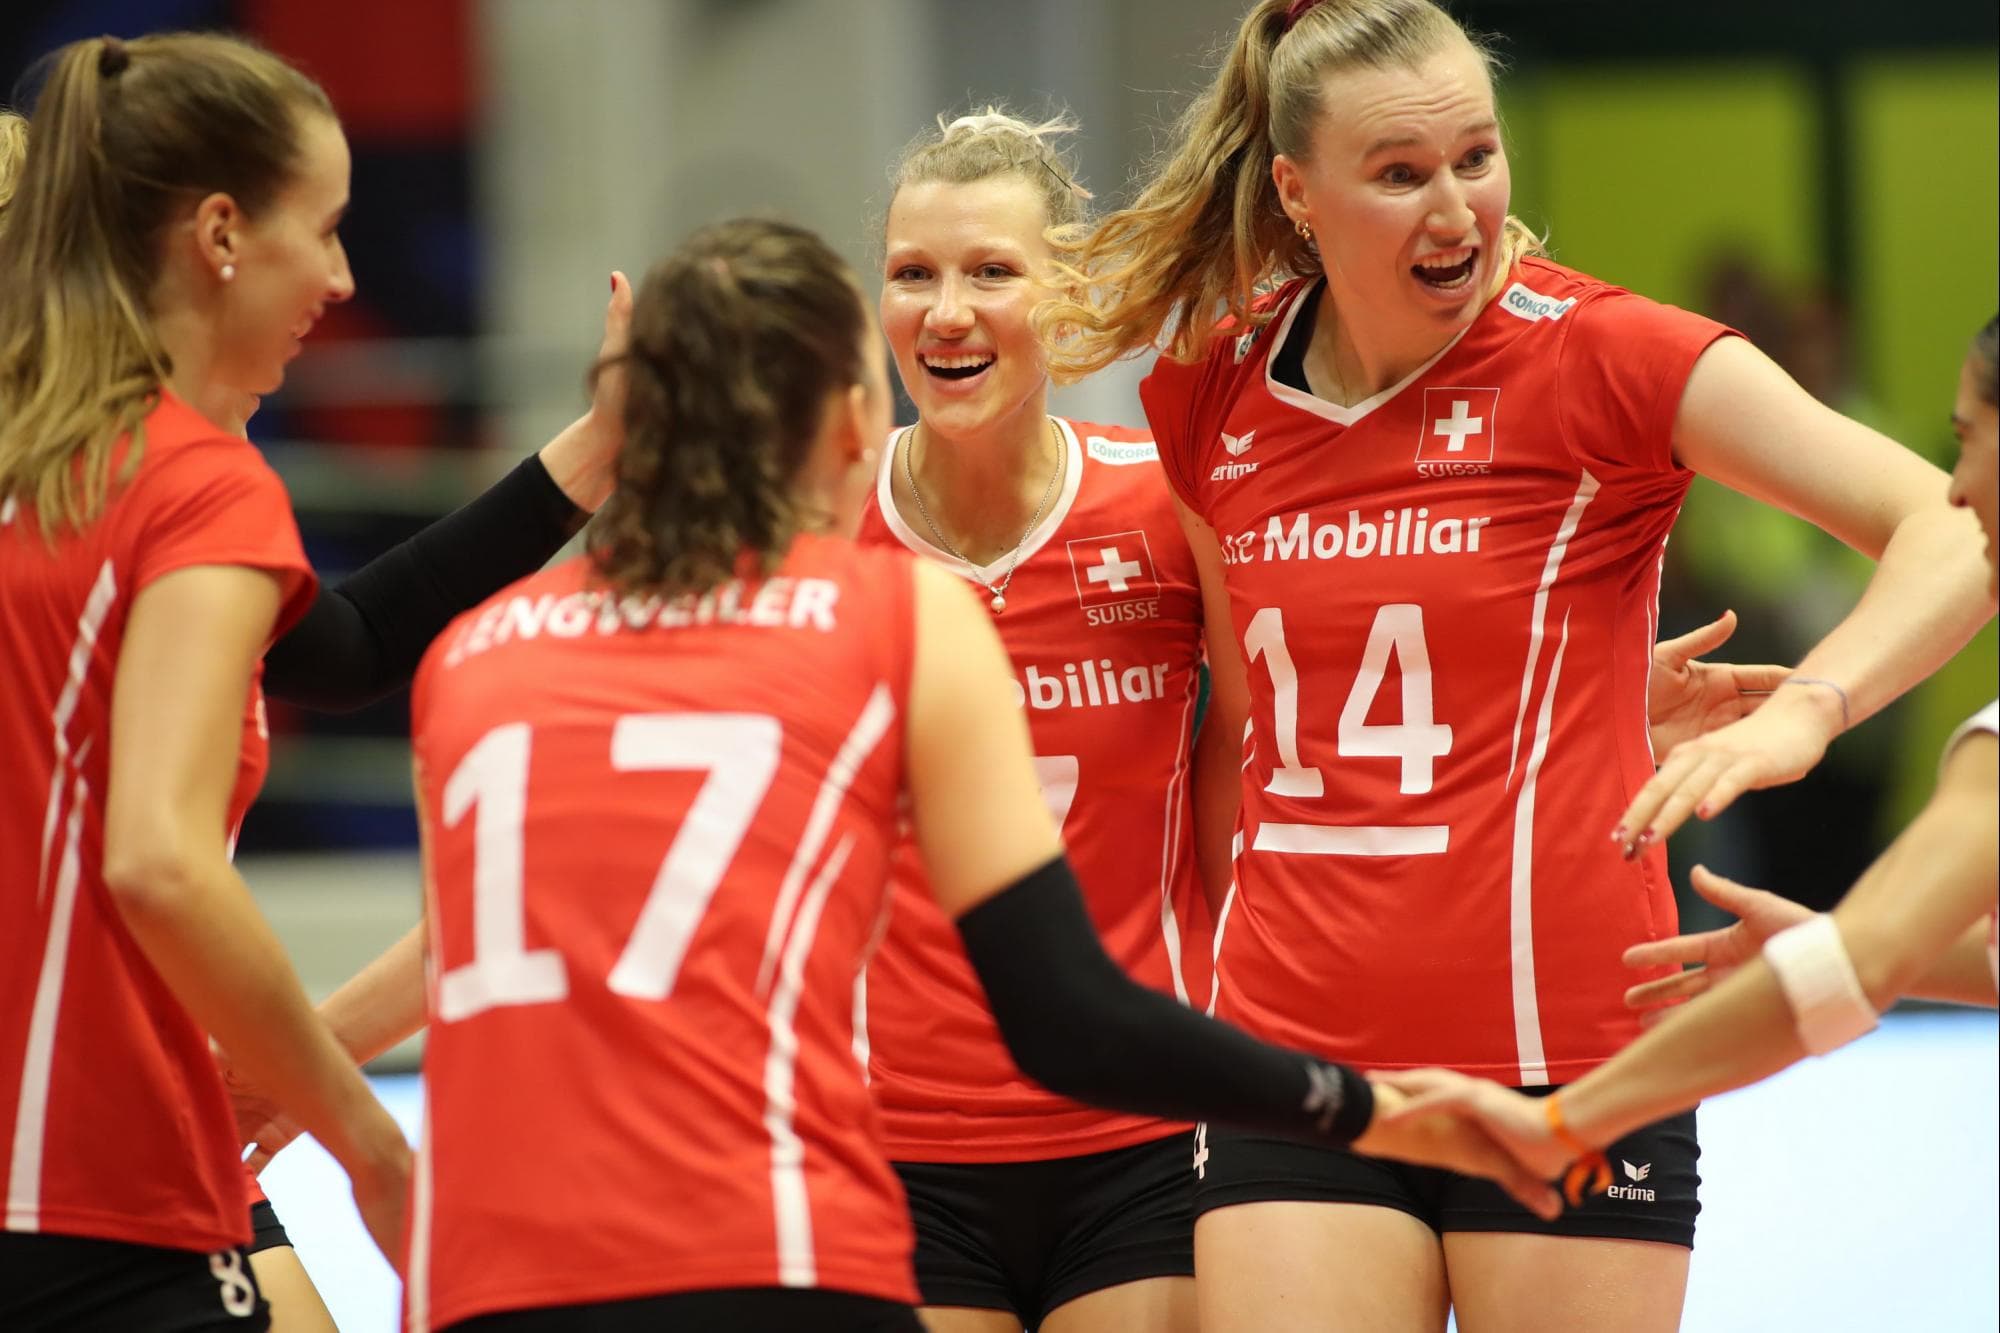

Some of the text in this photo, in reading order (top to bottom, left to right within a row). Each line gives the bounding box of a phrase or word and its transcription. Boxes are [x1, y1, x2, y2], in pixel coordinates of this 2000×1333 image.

[1092, 442, 1157, 459] CONCORD
[1417, 463, 1491, 479] SUISSE
[1263, 507, 1491, 561] Mobiliar
[1086, 601, 1160, 627] SUISSE
[1012, 658, 1169, 710] biliar
[1243, 603, 1454, 798] 14
[439, 713, 783, 1022] 17
[1607, 1184, 1656, 1202] erima
[208, 1249, 256, 1318] 8
